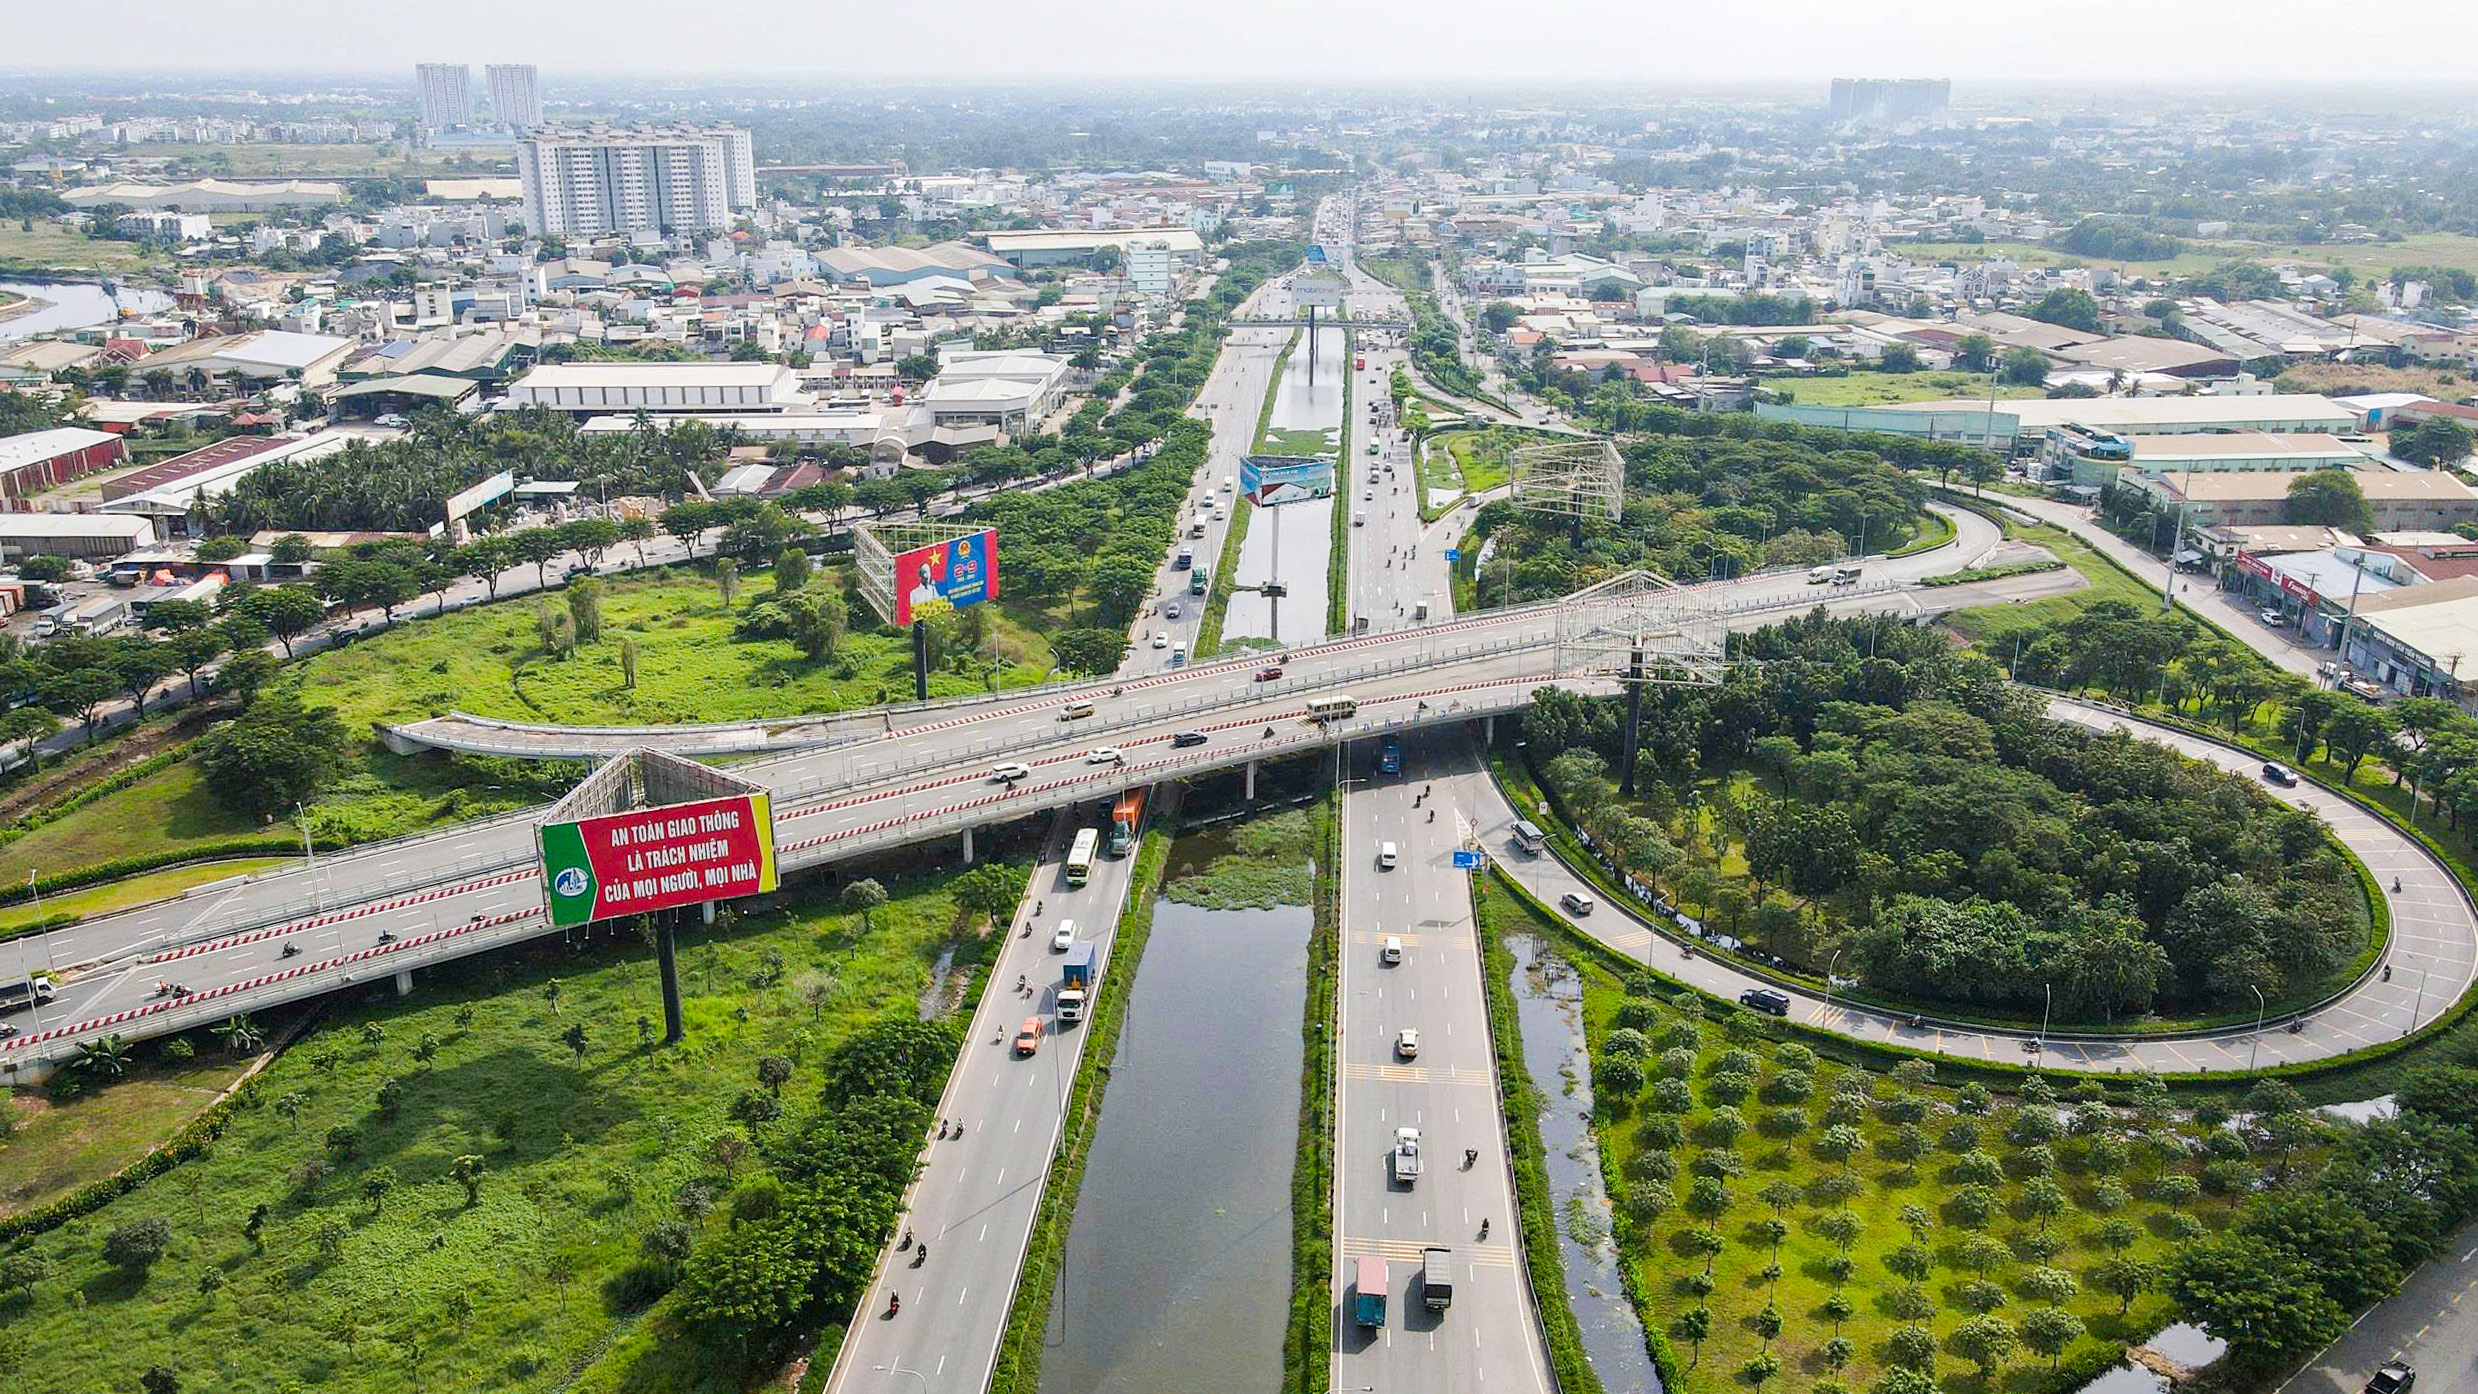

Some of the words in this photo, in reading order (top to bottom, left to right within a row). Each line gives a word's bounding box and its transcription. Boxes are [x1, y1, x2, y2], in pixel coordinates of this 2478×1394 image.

[611, 827, 629, 847] AN
[631, 820, 665, 844] TOÀN
[667, 817, 697, 838] GIAO
[699, 809, 740, 833] THÔNG
[627, 850, 644, 872] LÀ
[645, 845, 686, 869] TRÁCH
[689, 837, 729, 862] NHIỆM
[604, 878, 631, 903] CỦA
[632, 877, 658, 900] MỌI
[660, 868, 703, 894] NGƯỜI,
[704, 865, 729, 888] MỌI
[731, 859, 757, 882] NHÀ
